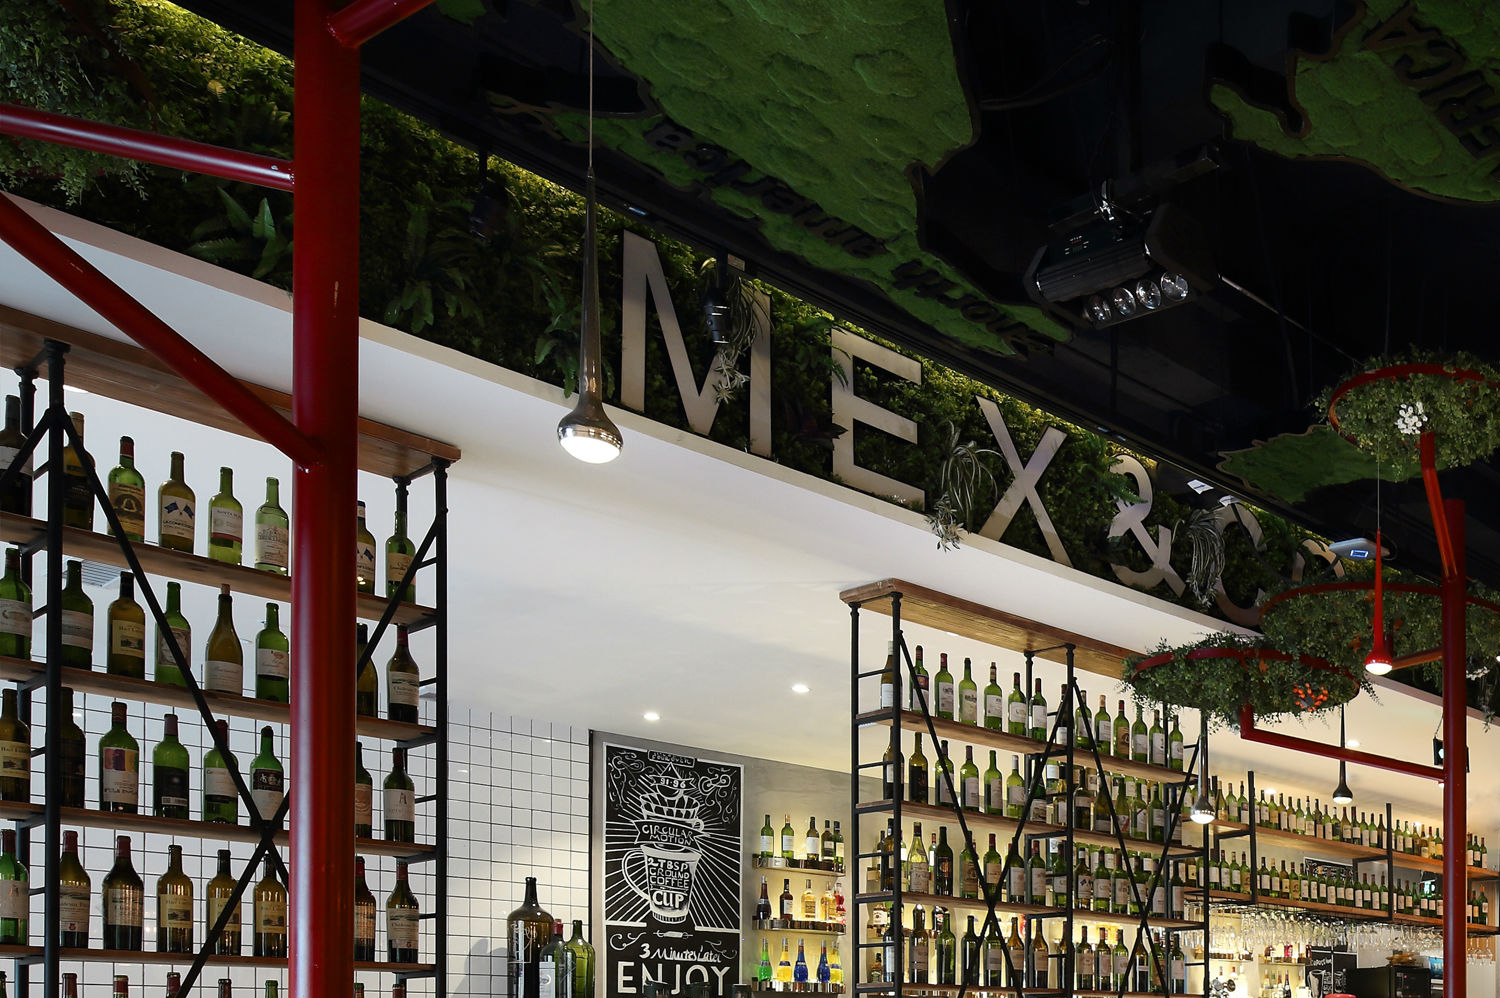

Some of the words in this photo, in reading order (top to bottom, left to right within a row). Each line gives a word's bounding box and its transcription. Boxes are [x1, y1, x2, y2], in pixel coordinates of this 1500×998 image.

[642, 825, 694, 841] CIRCULAR
[649, 834, 691, 846] MOTION
[649, 876, 690, 889] COFFEE
[652, 891, 685, 908] CUP
[639, 943, 651, 959] 3
[617, 961, 730, 996] ENJOY
